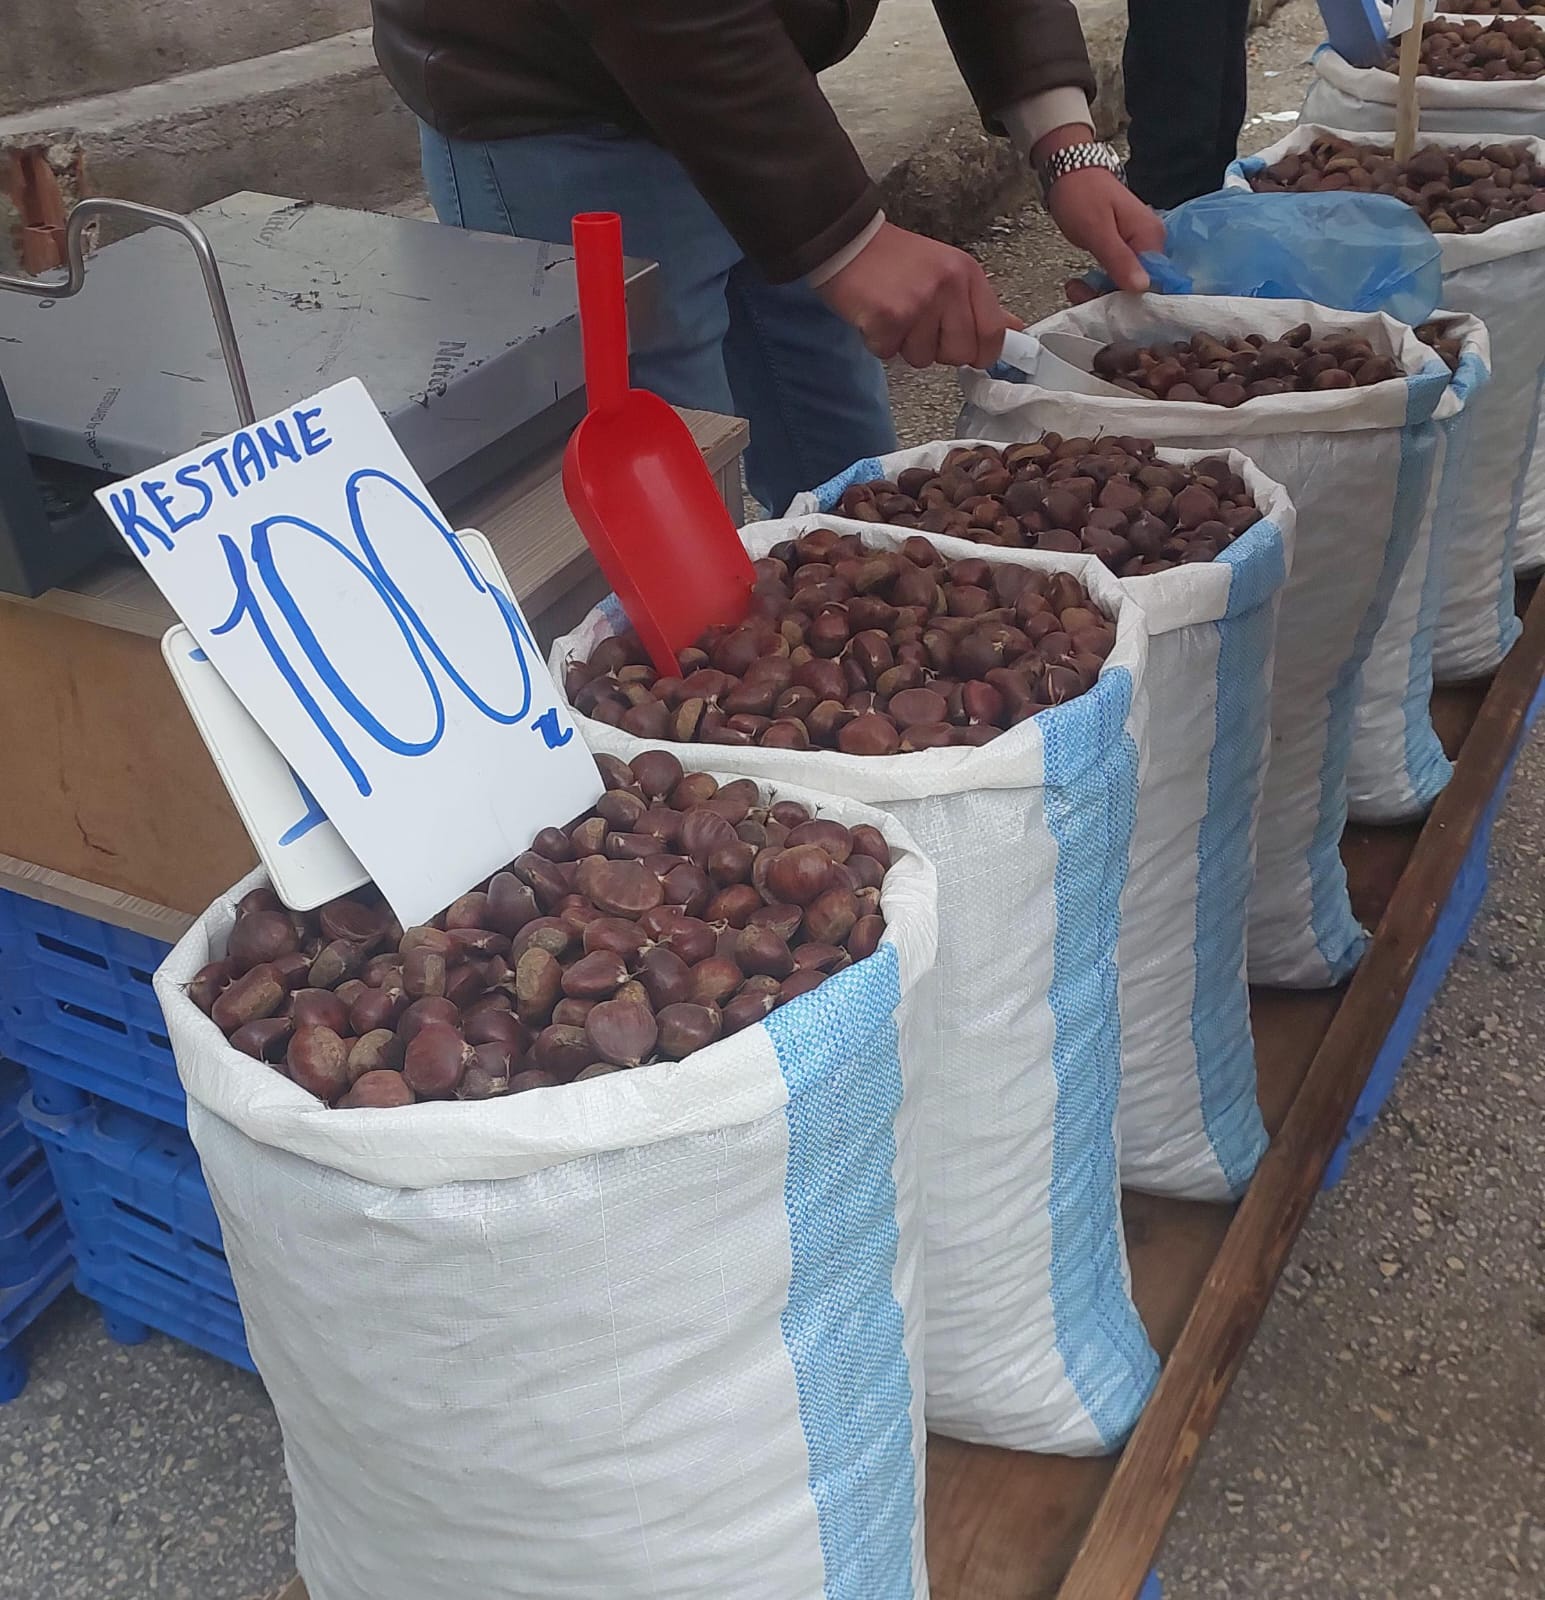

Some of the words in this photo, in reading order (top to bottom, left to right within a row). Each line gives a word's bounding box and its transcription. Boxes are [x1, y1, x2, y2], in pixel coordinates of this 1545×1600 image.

[428, 341, 467, 397] Nitto
[109, 407, 332, 557] KESTANE
[210, 468, 534, 797] 100
